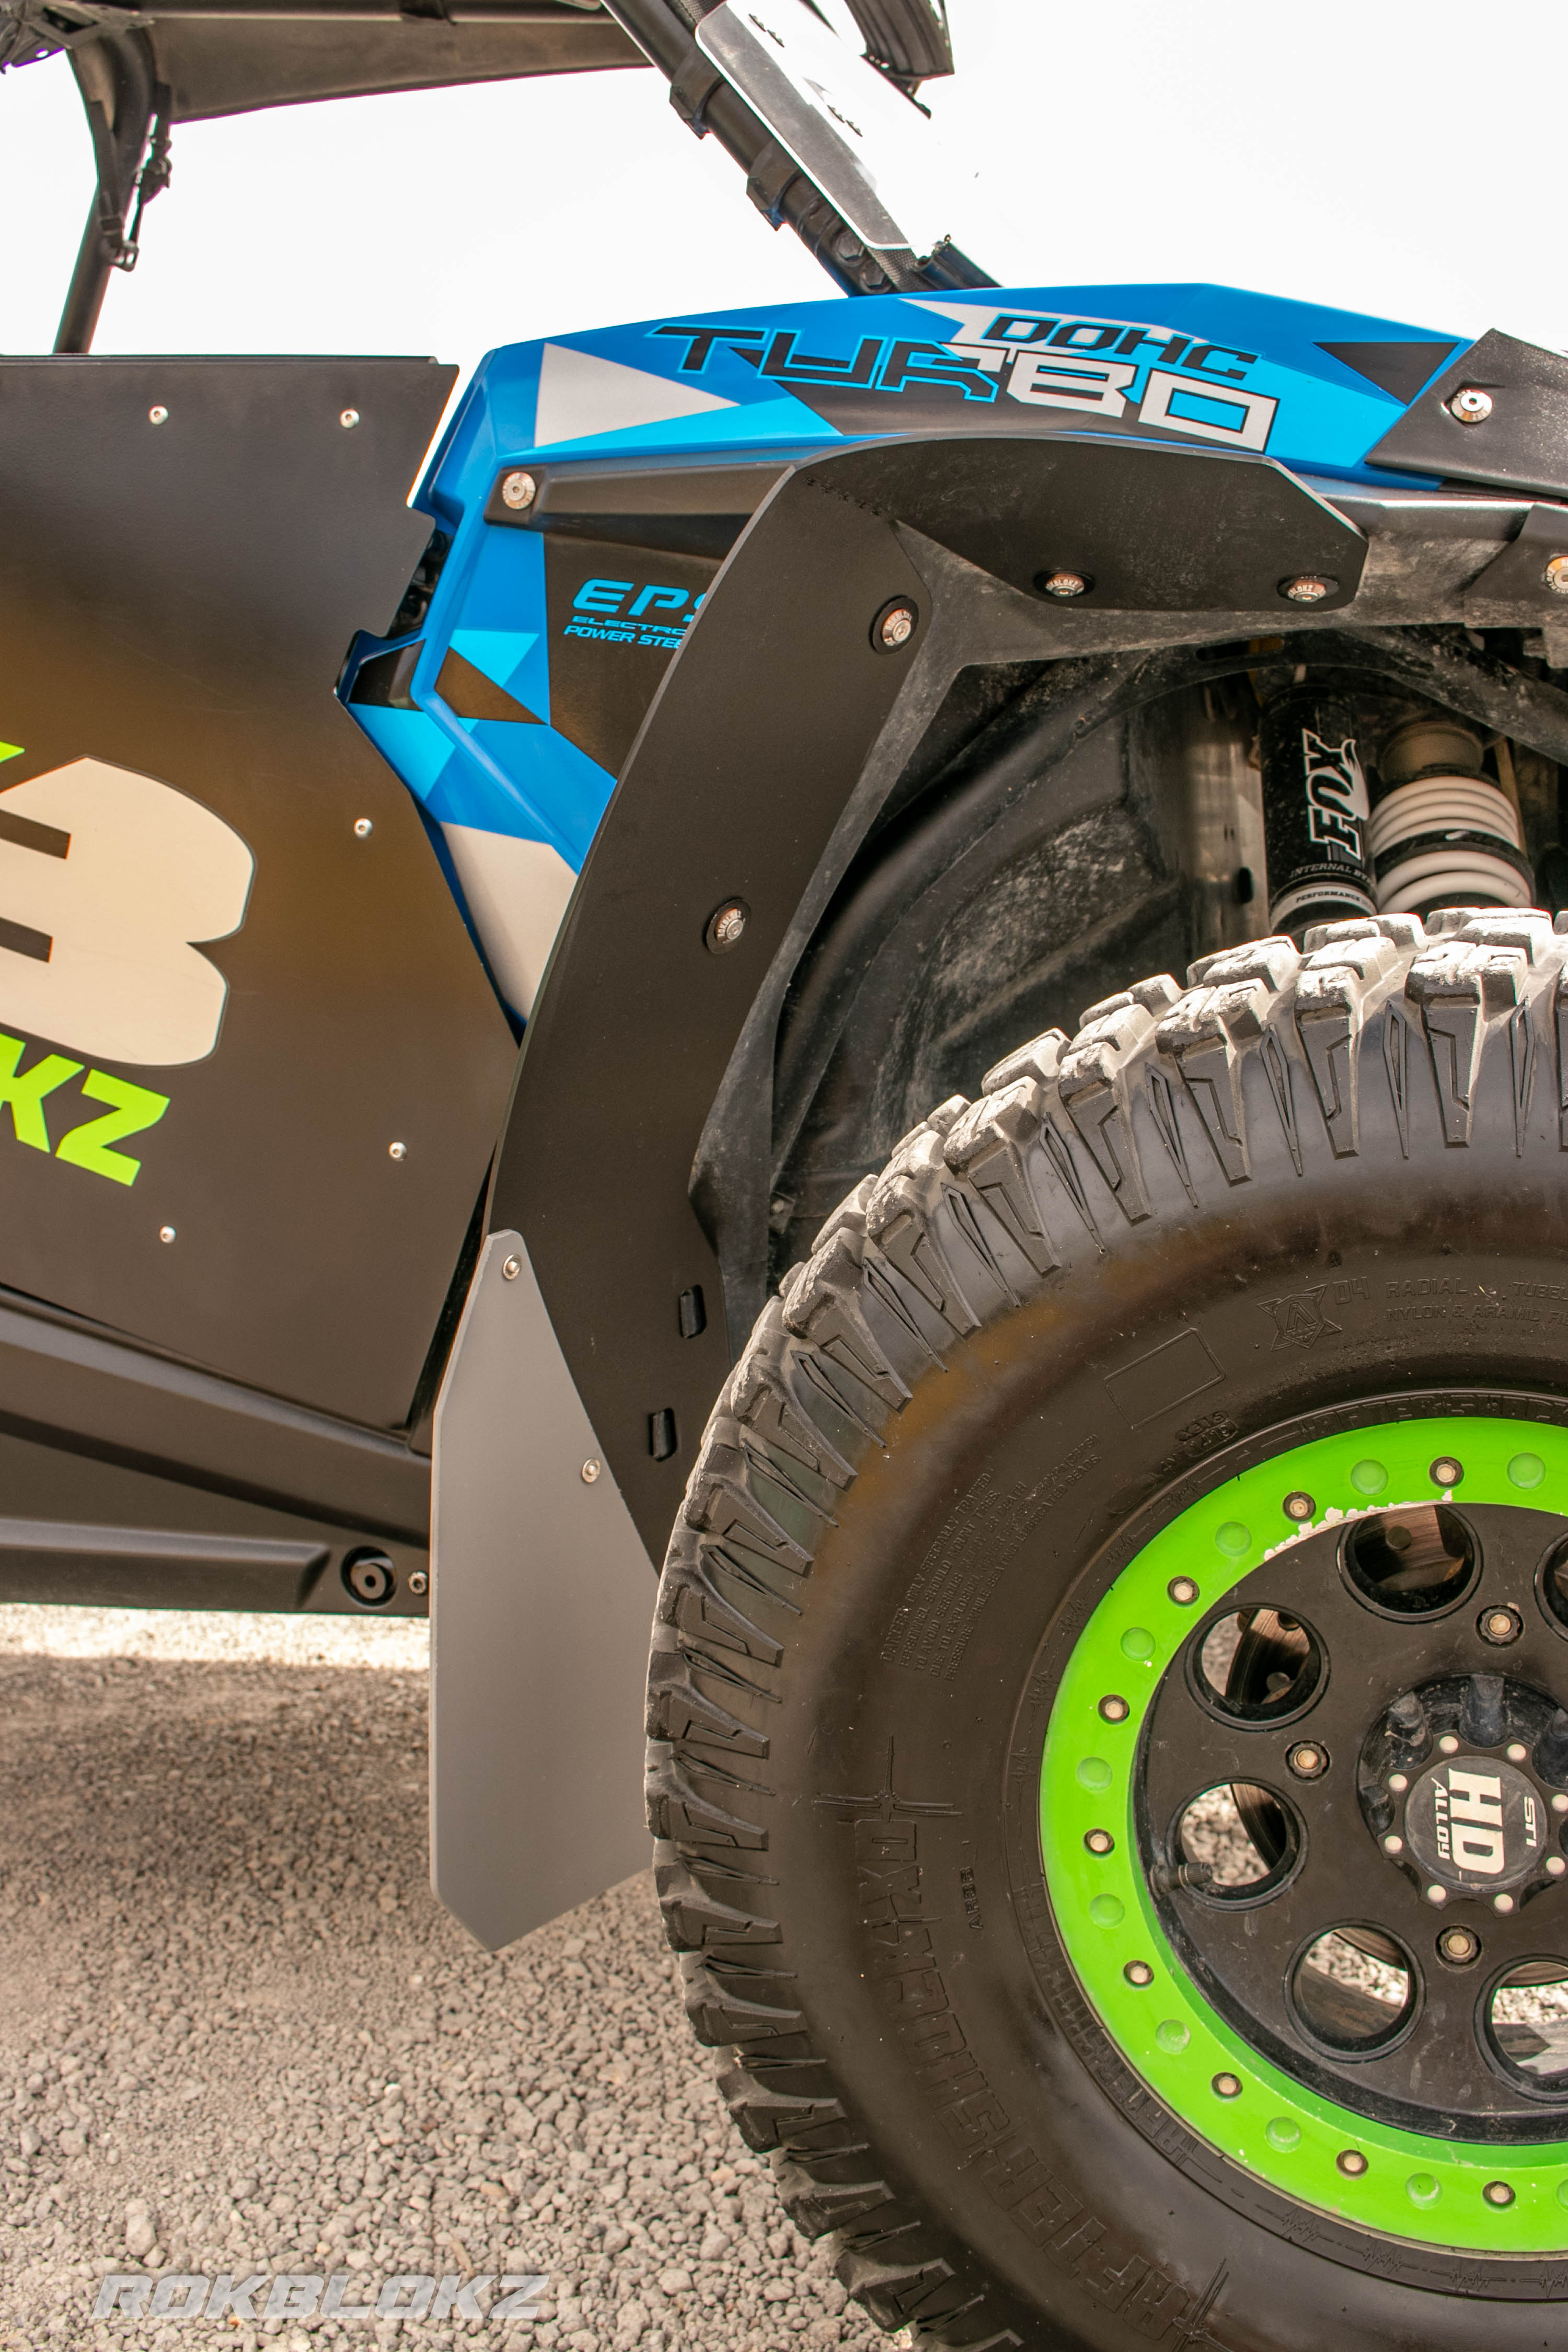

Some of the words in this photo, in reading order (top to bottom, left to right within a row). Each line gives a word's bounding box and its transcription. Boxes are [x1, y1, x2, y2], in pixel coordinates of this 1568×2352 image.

[982, 313, 1260, 380] DOHC
[563, 625, 635, 643] POWER
[1302, 728, 1368, 860] FOX
[1289, 863, 1352, 879] INTERNAL
[1296, 891, 1361, 903] PERFORMANCE
[1385, 1277, 1467, 1299] RADIAL
[1386, 1306, 1446, 1322] NYLON
[1471, 1305, 1540, 1322] ARAMID
[899, 1606, 931, 1668] PERSONNEL
[925, 1559, 953, 1604] SHOULD
[946, 1520, 977, 1560] MOUNT
[906, 1573, 926, 1603] ONLY
[914, 1655, 928, 1673] TO
[923, 1619, 942, 1655] AVOID
[936, 1572, 964, 1619] SERIOUS
[997, 1480, 1029, 1518] DEATH
[944, 1624, 974, 1681] PRESSURE
[966, 1587, 993, 1623] WHILE
[987, 1542, 1020, 1588] SEATING
[930, 1654, 946, 1678] DUE
[940, 1635, 952, 1652] TO
[1431, 1777, 1450, 1860] ALLOY
[1448, 1767, 1505, 1874] HD
[1524, 1796, 1537, 1847] STI
